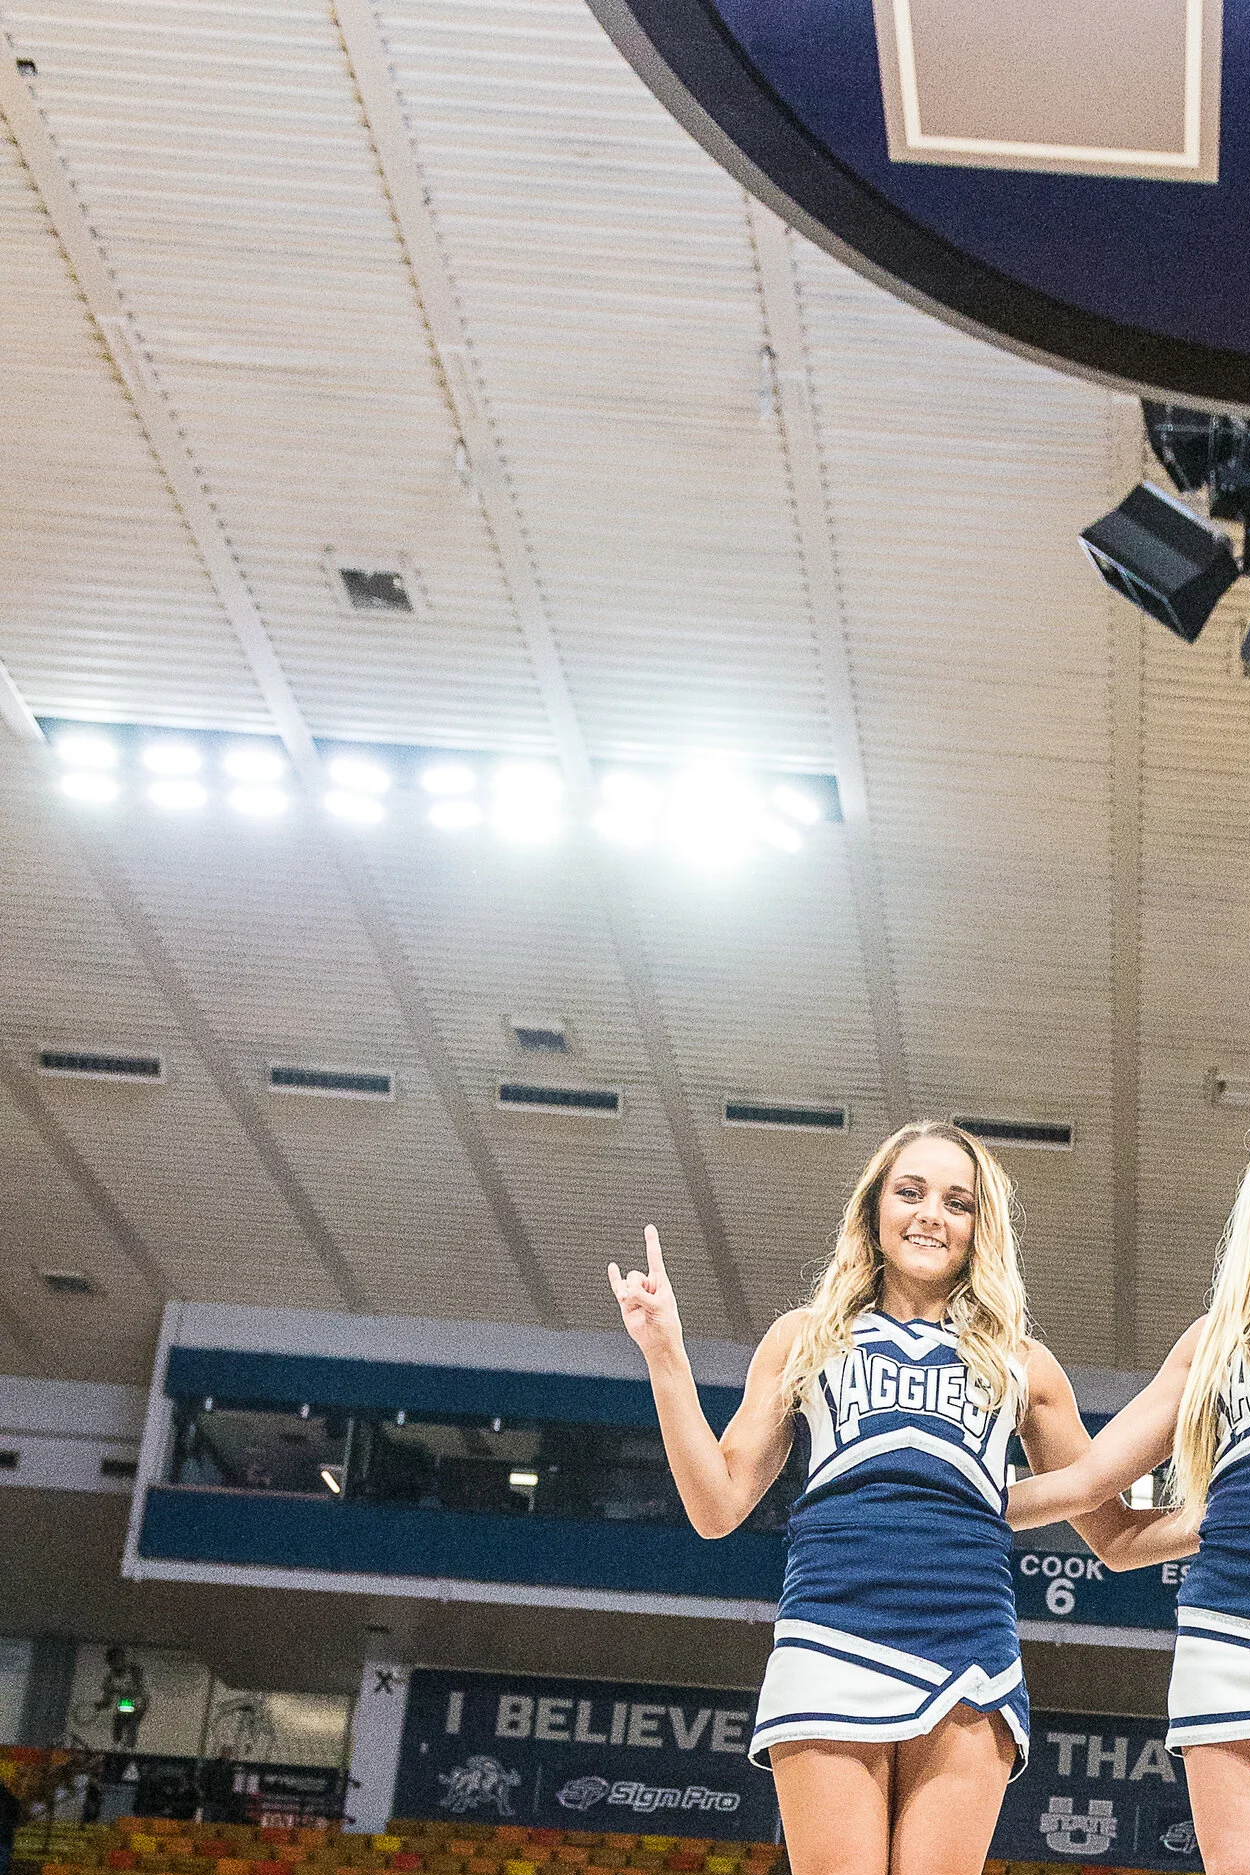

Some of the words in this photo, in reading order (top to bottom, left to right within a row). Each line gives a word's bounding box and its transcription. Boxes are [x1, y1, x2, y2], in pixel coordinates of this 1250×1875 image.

[839, 1346, 989, 1439] AGGIES
[1020, 1554, 1104, 1581] COOK
[1045, 1577, 1076, 1615] 6
[374, 1670, 394, 1693] X
[445, 1690, 463, 1735] I
[496, 1694, 751, 1753] BELIEVE
